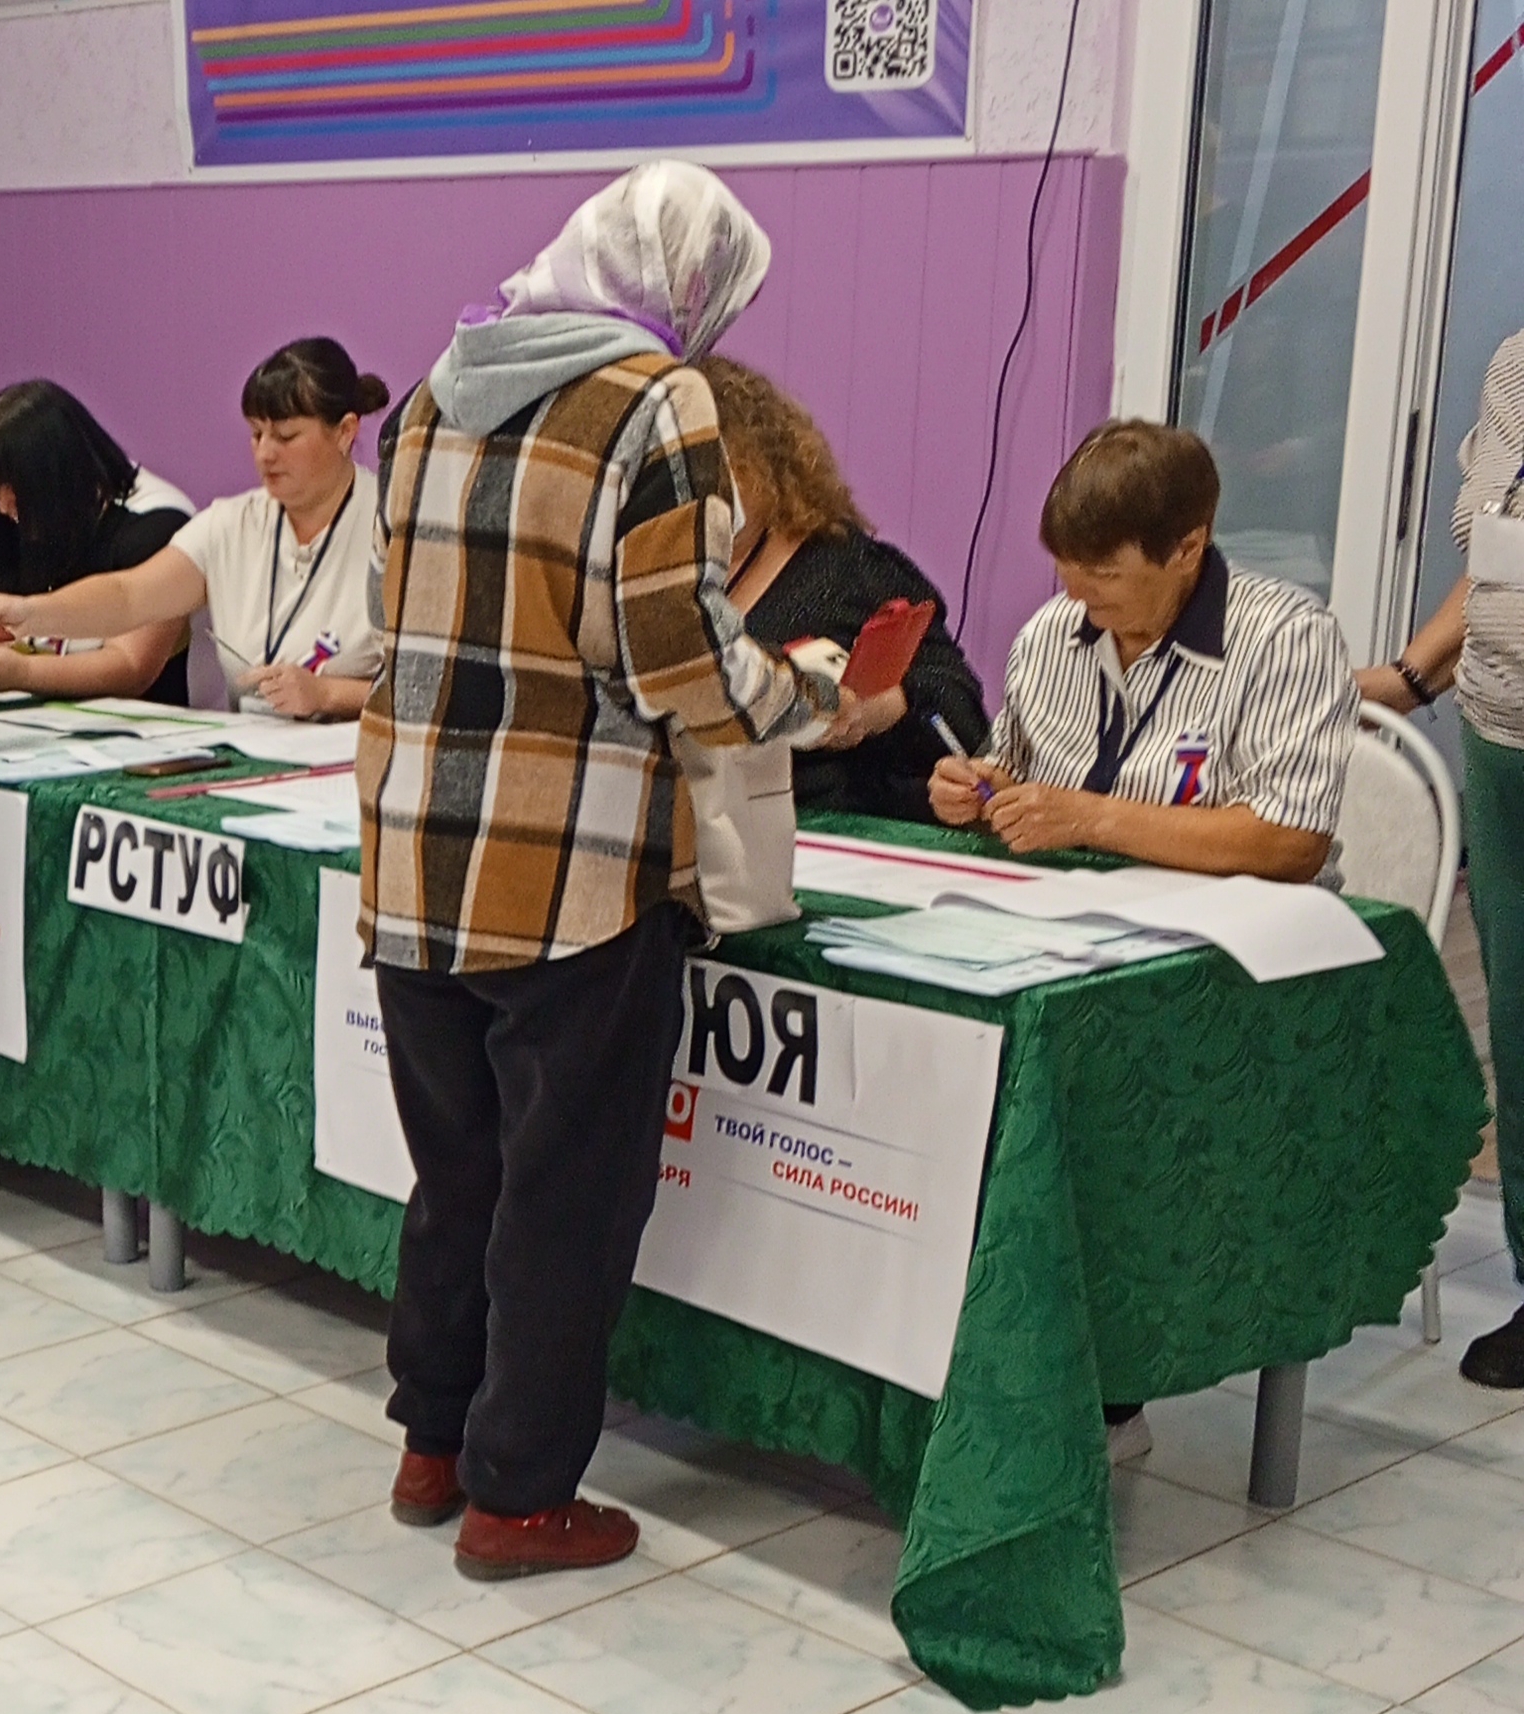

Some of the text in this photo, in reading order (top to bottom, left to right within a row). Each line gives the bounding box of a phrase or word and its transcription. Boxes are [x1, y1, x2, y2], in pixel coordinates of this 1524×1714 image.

[75, 812, 241, 924] РСТУФ
[714, 1114, 765, 1148] ТВОЙ
[769, 1132, 834, 1166] ГОЛОС
[772, 1160, 920, 1222] СИЛА РОССИИ!
